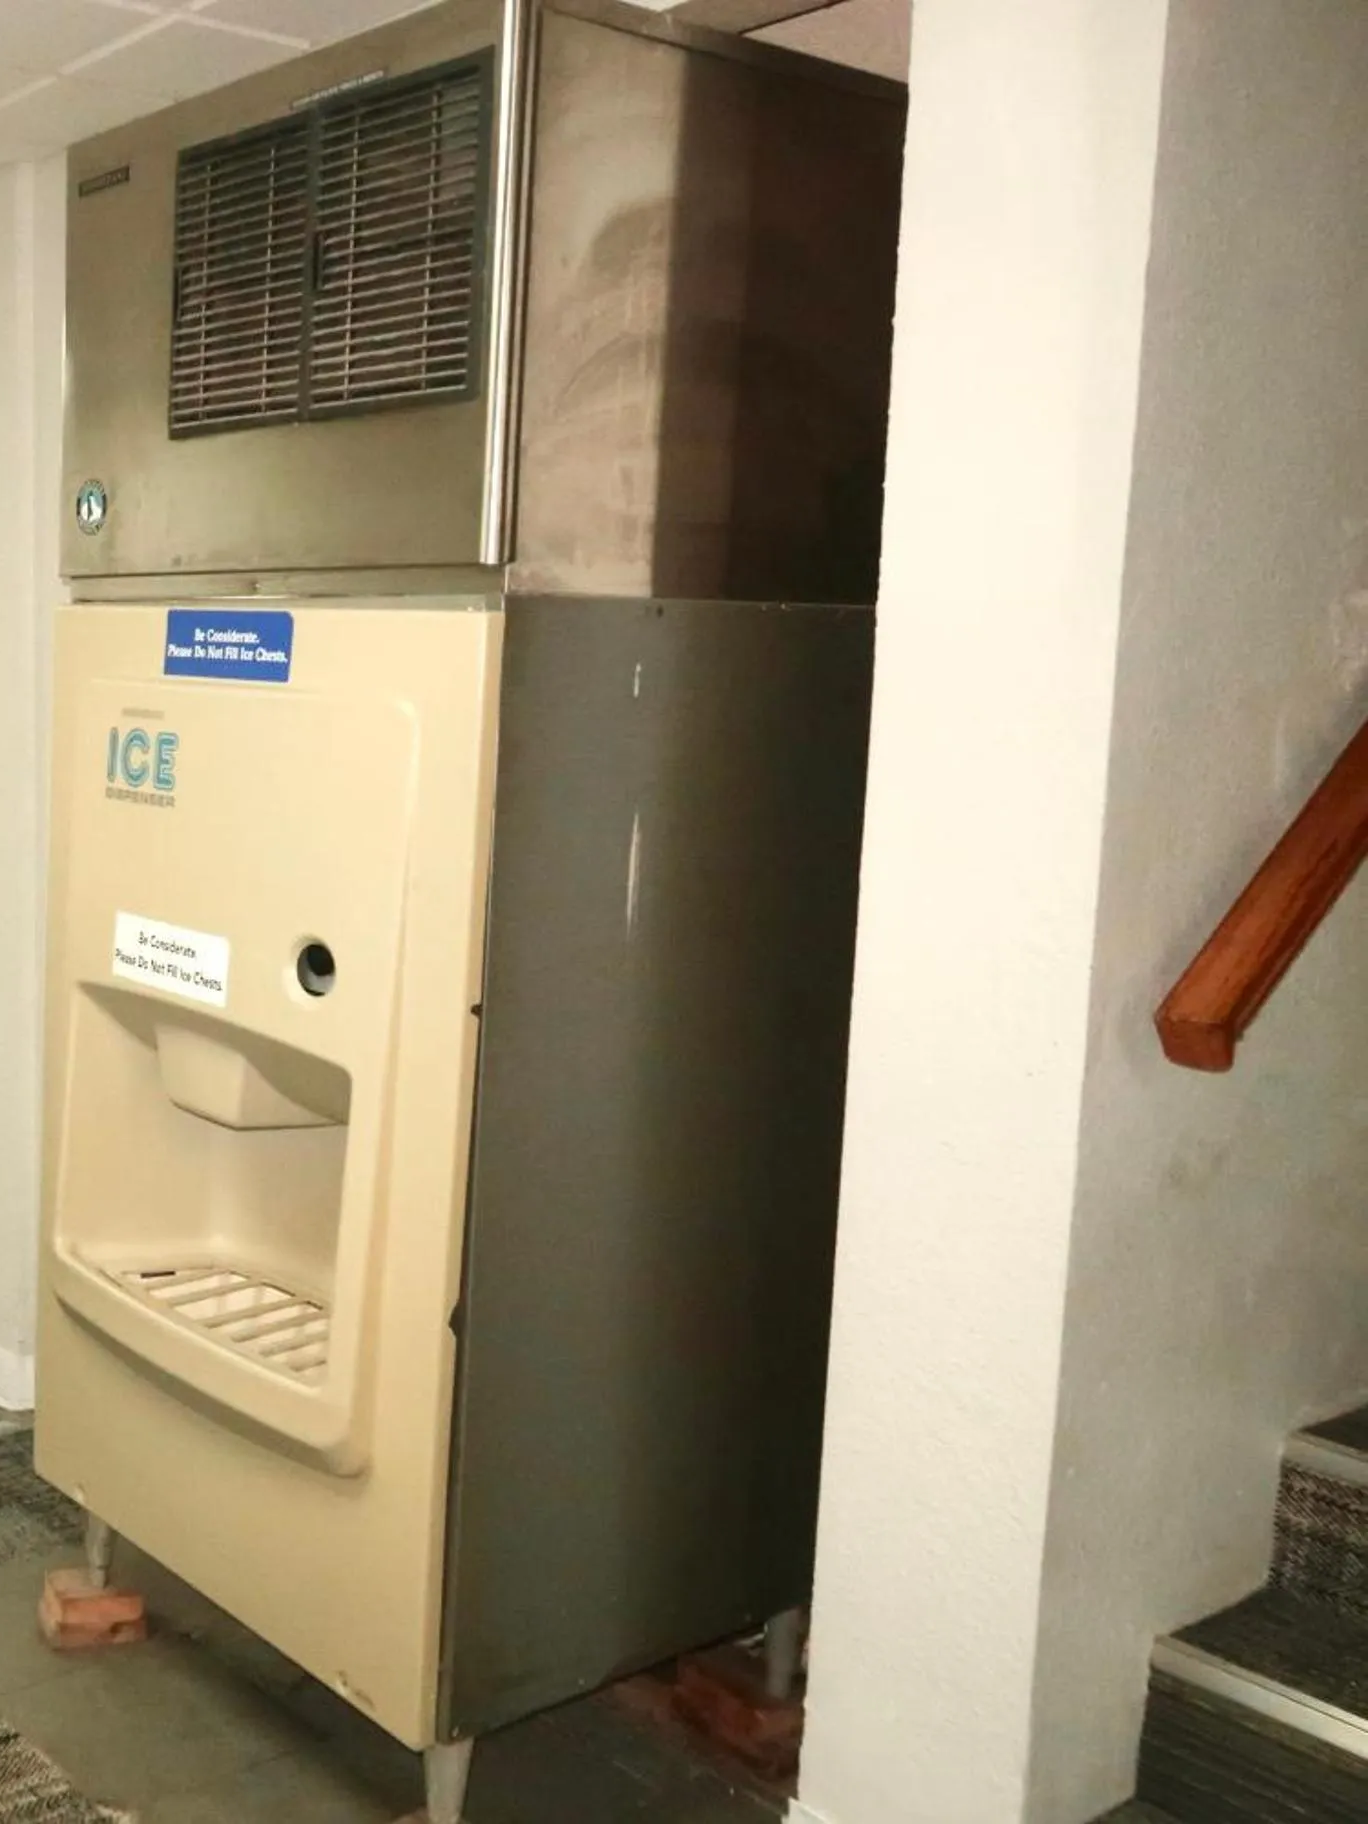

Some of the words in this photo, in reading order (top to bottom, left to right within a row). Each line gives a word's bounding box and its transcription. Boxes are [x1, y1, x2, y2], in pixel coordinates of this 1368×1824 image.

[194, 645, 206, 659] Do
[207, 645, 224, 660] Not
[225, 646, 239, 660] Fill
[107, 726, 179, 790] ICE
[137, 955, 149, 970] Do
